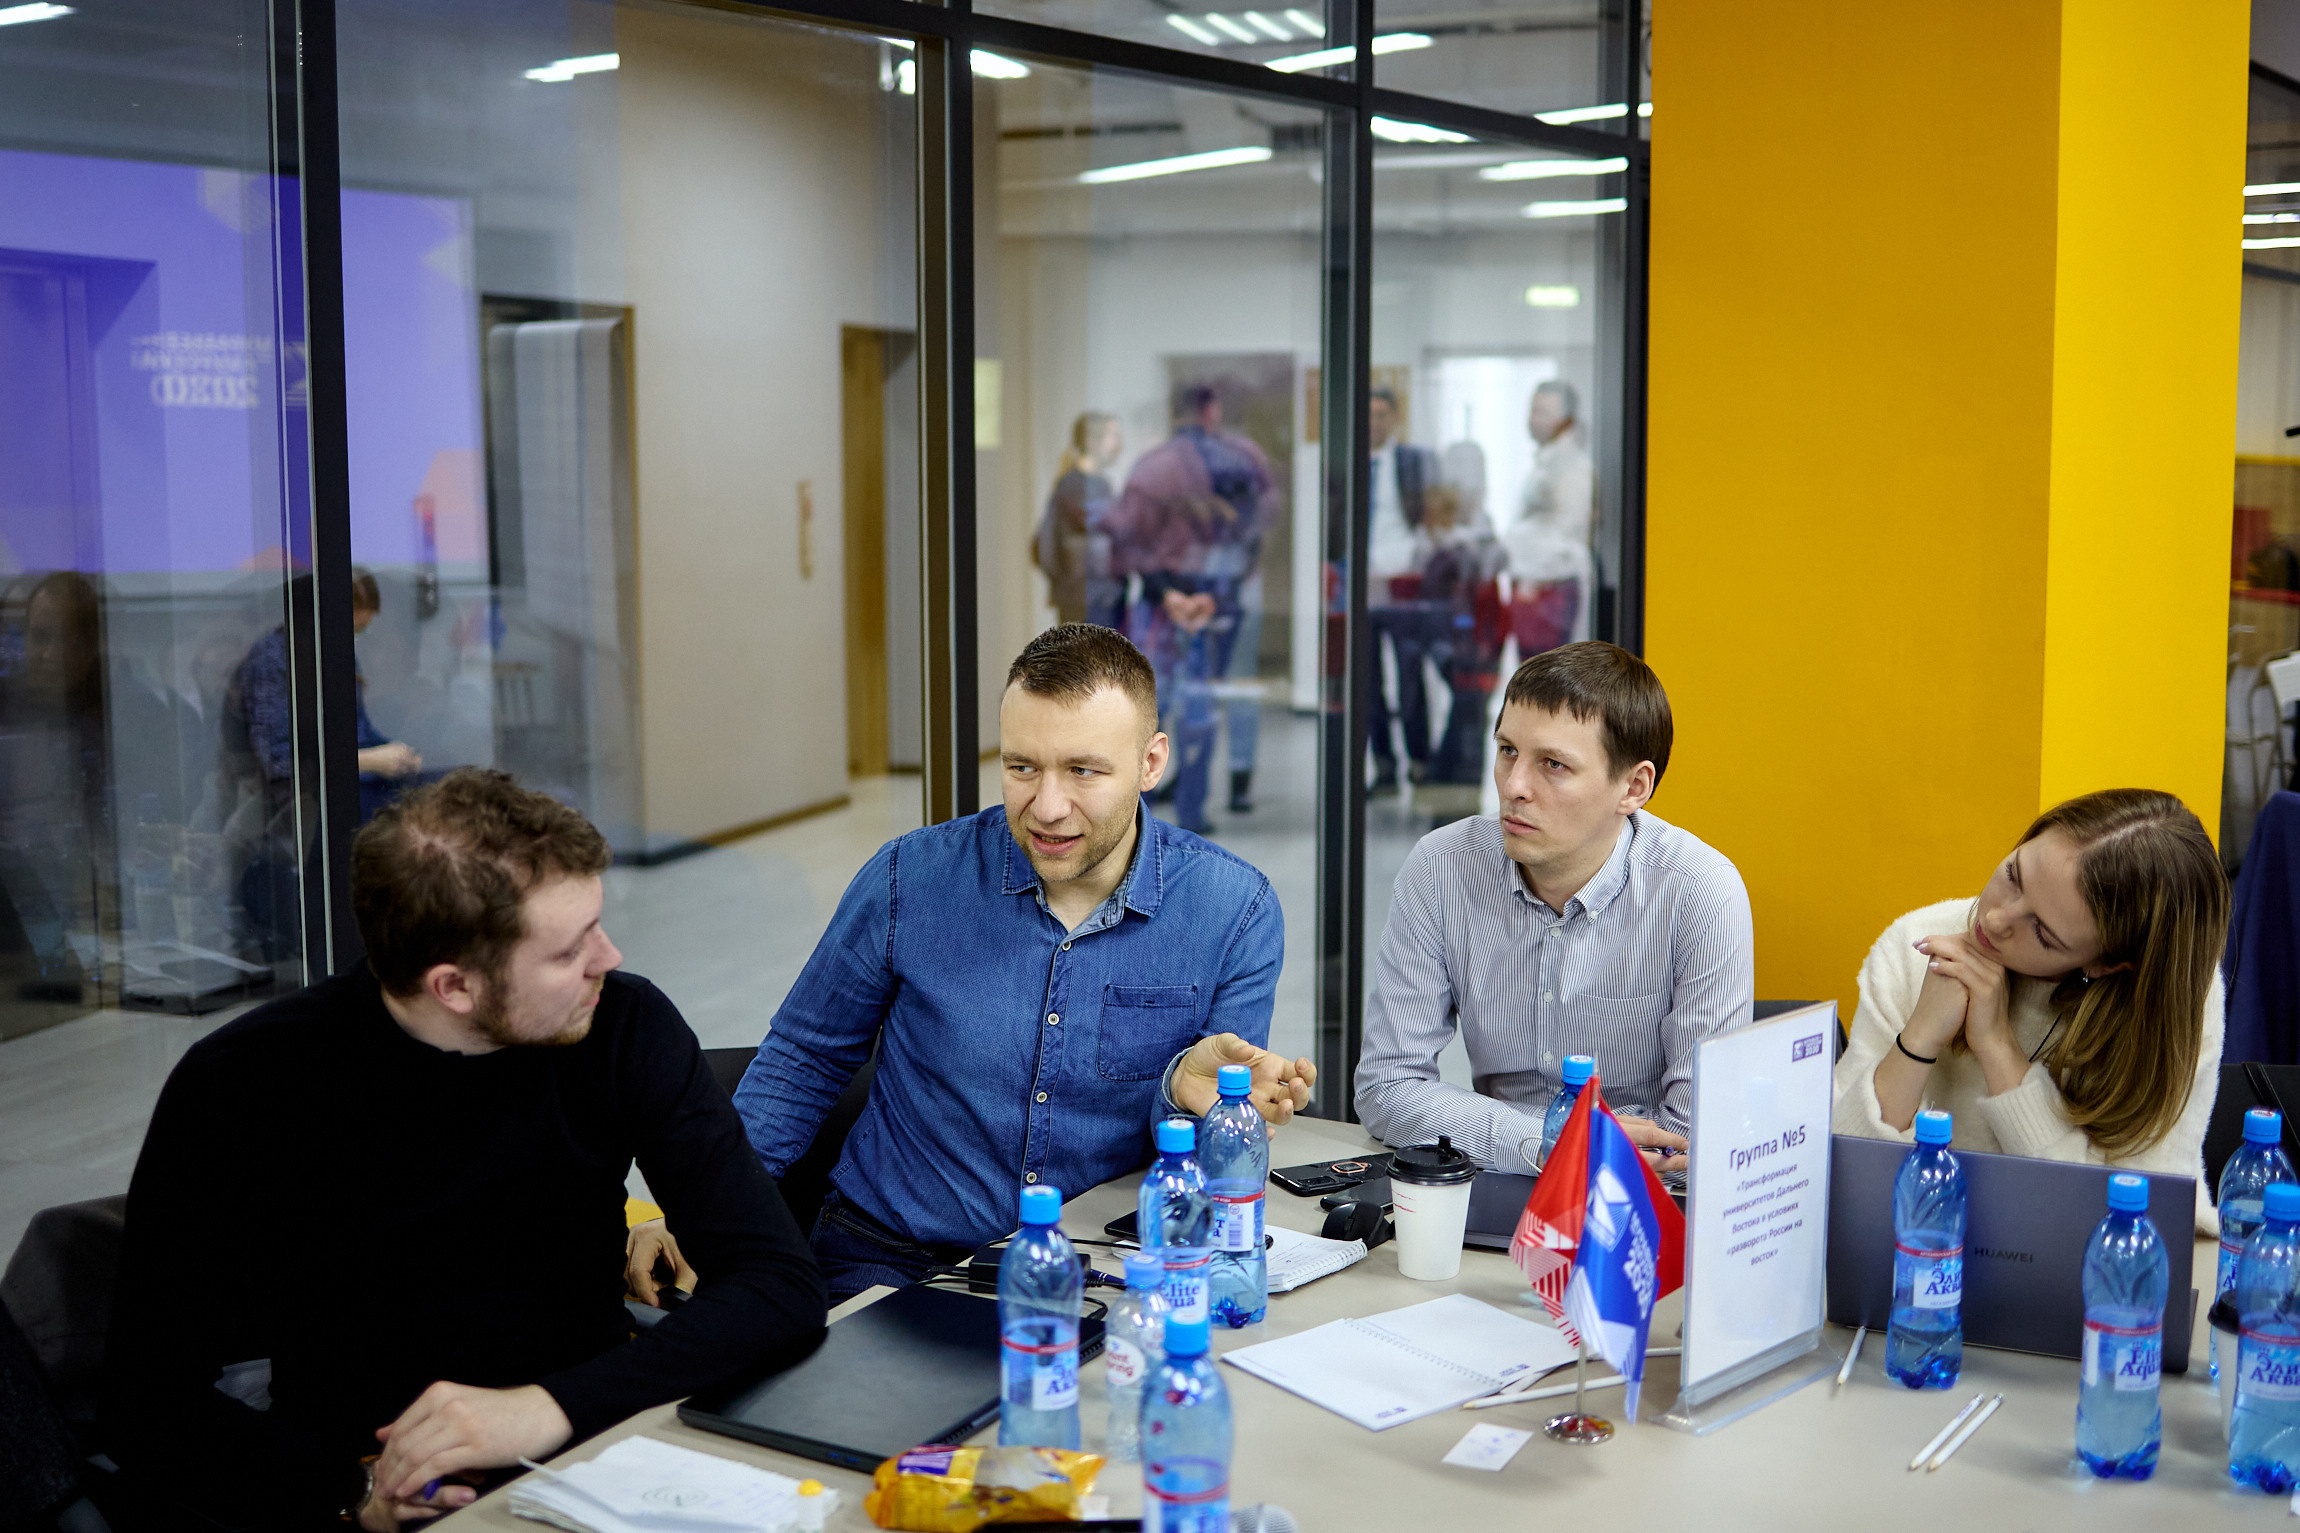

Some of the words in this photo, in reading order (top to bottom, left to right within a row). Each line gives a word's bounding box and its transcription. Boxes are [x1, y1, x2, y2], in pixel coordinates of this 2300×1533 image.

[1729, 1138, 1778, 1171] Группа
[1782, 1124, 1806, 1150] №5
[1736, 1163, 1798, 1191] «Трансформация
[1722, 1190, 1775, 1219] университетов
[1775, 1178, 1810, 1199] Дальнего
[1732, 1216, 1760, 1234] Востока
[1767, 1201, 1799, 1221] условиях
[1726, 1231, 1768, 1257] «разворота
[1768, 1224, 1793, 1240] России
[1794, 1218, 1803, 1229] на
[1750, 1247, 1779, 1266] восток»
[1974, 1247, 2034, 1263] HUAWEI
[1932, 1269, 1961, 1285] Эли
[2119, 1361, 2159, 1380] Aqu
[2257, 1353, 2300, 1375] Эли
